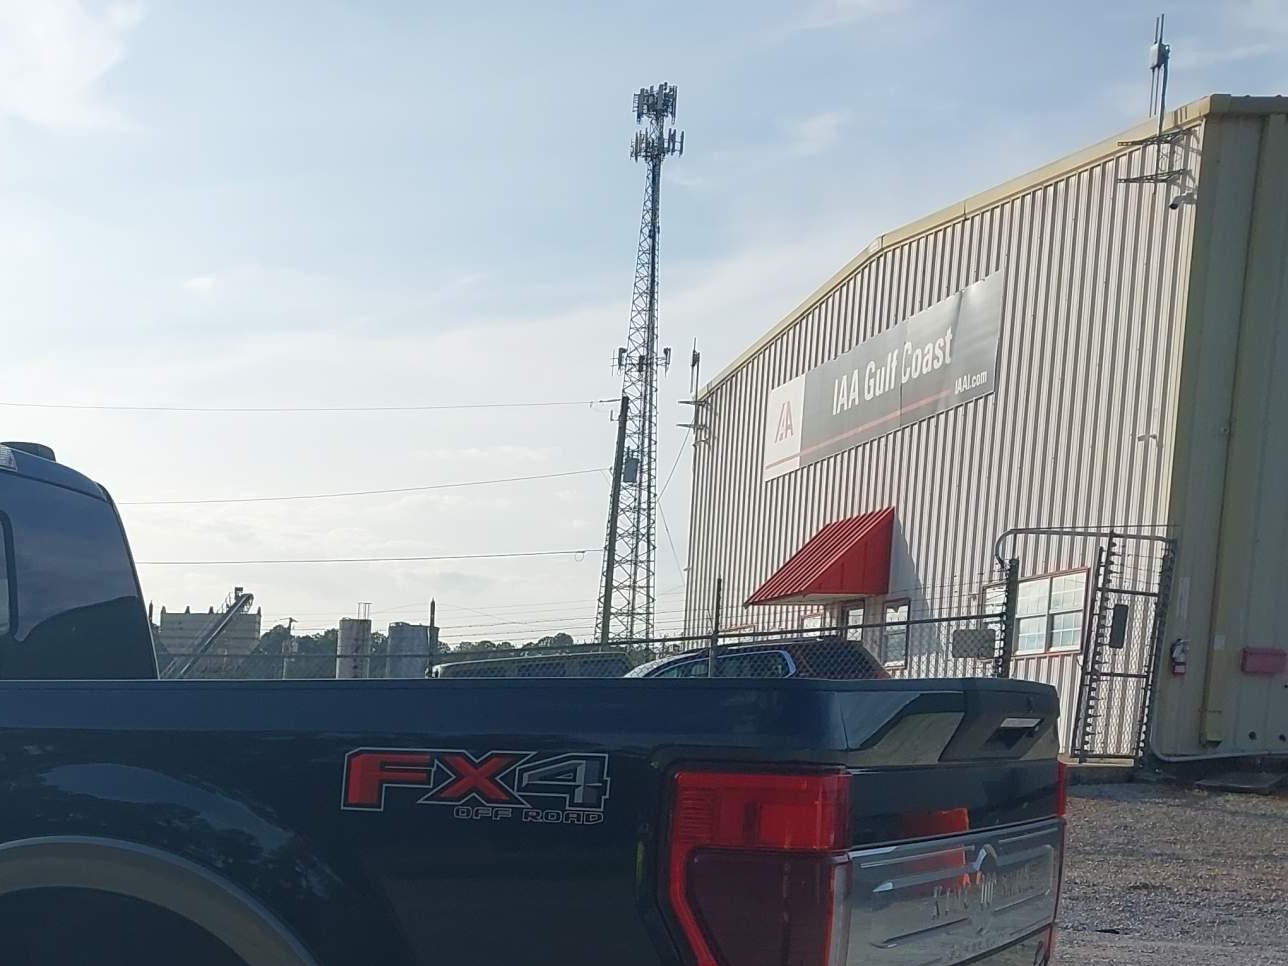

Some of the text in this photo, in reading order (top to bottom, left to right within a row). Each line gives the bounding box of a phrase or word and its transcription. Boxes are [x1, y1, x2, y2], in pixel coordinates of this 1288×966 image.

[833, 327, 953, 416] IAA Gulf Coast
[340, 746, 611, 812] FX4
[454, 806, 605, 825] OFF ROAD
